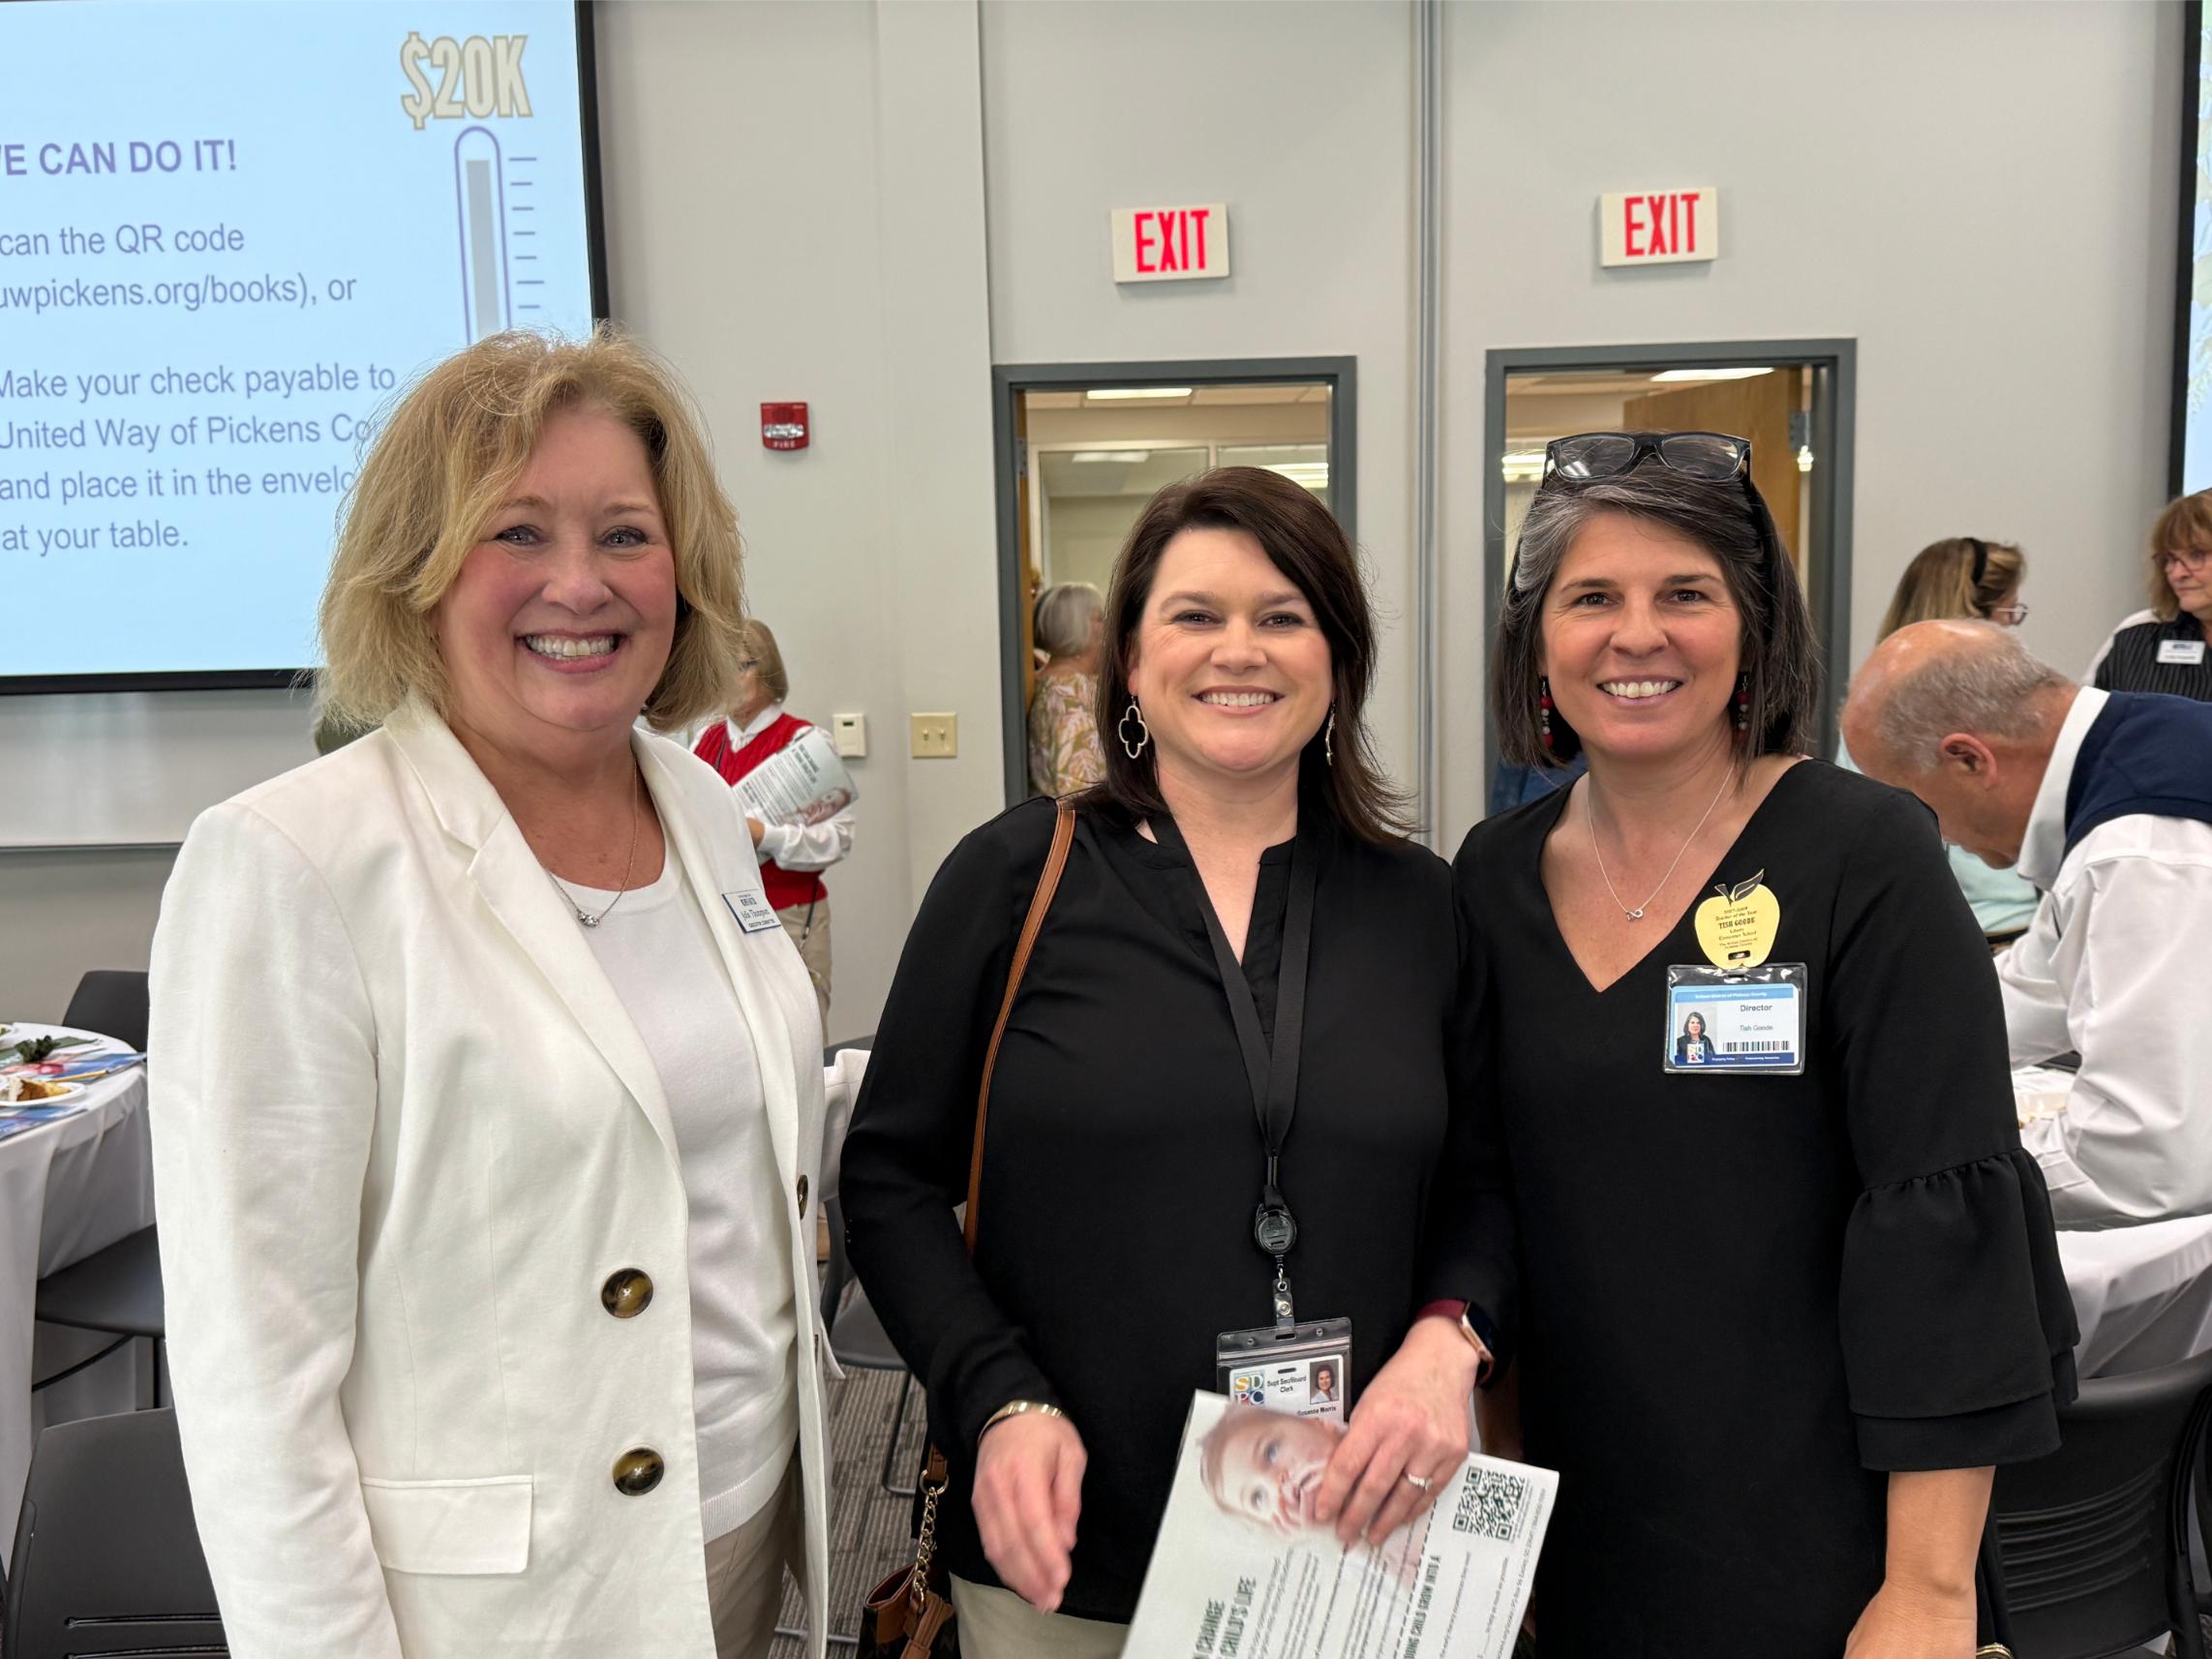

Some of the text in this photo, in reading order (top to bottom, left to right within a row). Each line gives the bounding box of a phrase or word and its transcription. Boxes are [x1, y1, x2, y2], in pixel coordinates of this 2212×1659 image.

[400, 31, 533, 130] $20K
[39, 141, 116, 175] CAN
[129, 139, 182, 173] DO
[194, 138, 237, 171] IT!
[59, 226, 106, 256] the
[115, 224, 165, 255] QR
[174, 223, 244, 253] code
[1135, 209, 1209, 274] EXIT
[1624, 193, 1700, 257] EXIT
[327, 277, 357, 300] or
[77, 373, 140, 404] your
[150, 365, 235, 395] check
[245, 362, 359, 399] payable
[369, 363, 395, 390] to
[95, 418, 161, 453] Way
[170, 415, 197, 445] of
[207, 414, 320, 444] Pickens
[0, 470, 50, 500] and
[61, 469, 137, 505] place
[147, 468, 164, 497] it
[172, 468, 197, 496] in
[206, 467, 251, 496] the
[2, 519, 188, 558] at your table.
[1740, 1004, 1773, 1012] Director
